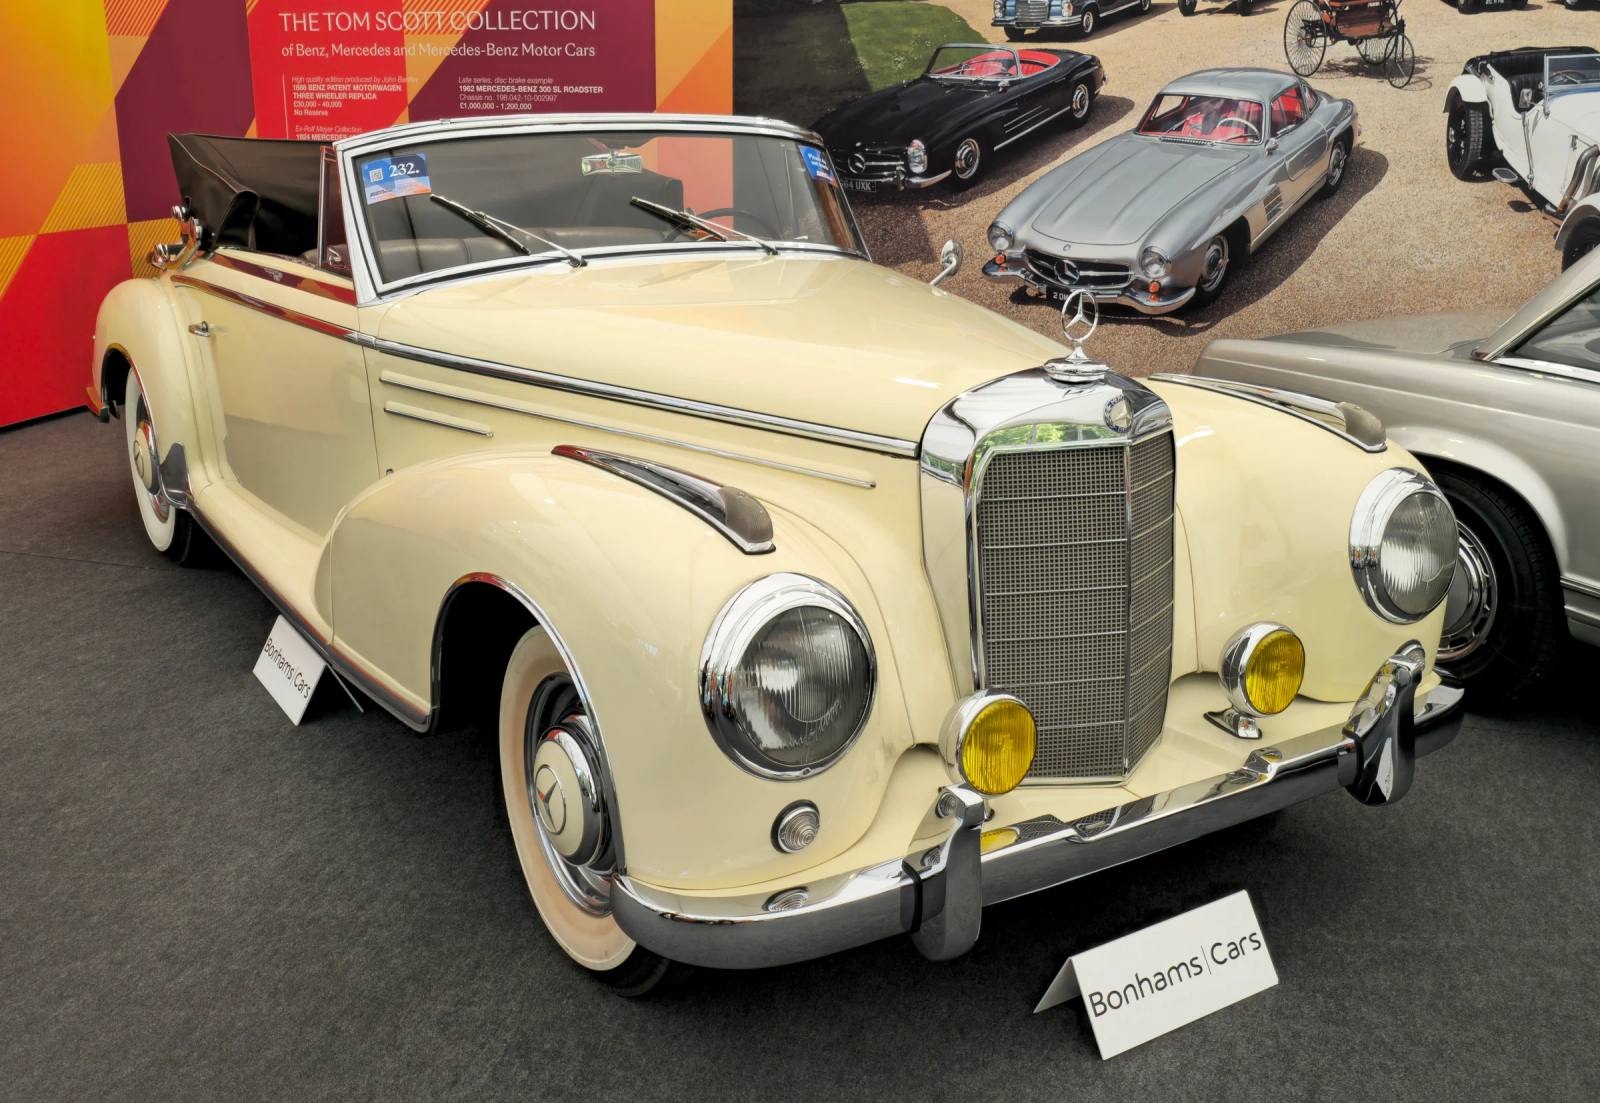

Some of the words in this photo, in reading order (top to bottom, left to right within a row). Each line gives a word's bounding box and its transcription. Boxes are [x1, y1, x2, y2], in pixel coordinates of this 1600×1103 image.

[278, 12, 320, 32] THE
[322, 12, 370, 31] TOM
[375, 11, 445, 31] SCOTT
[450, 10, 596, 31] COLLECTION
[281, 44, 293, 57] of
[296, 44, 329, 58] Benz,
[331, 43, 390, 57] Mercedes
[393, 43, 416, 57] and
[418, 43, 518, 57] Mercedes-Benz
[522, 43, 562, 57] Motor
[565, 43, 596, 57] Cars
[352, 84, 402, 92] MOTORWAGEN
[475, 85, 537, 93] MERCEDES-BENZ
[563, 86, 604, 94] ROADSTER
[293, 92, 315, 100] THREE
[315, 92, 348, 100] WHEELER
[459, 102, 495, 110] £1,000,000
[500, 102, 532, 110] 1,200,000
[855, 181, 871, 191] UXK
[264, 638, 295, 681] Bonhams
[294, 672, 311, 699] Cars
[1088, 956, 1204, 1018] Bonhams
[1210, 932, 1263, 966] Cars
